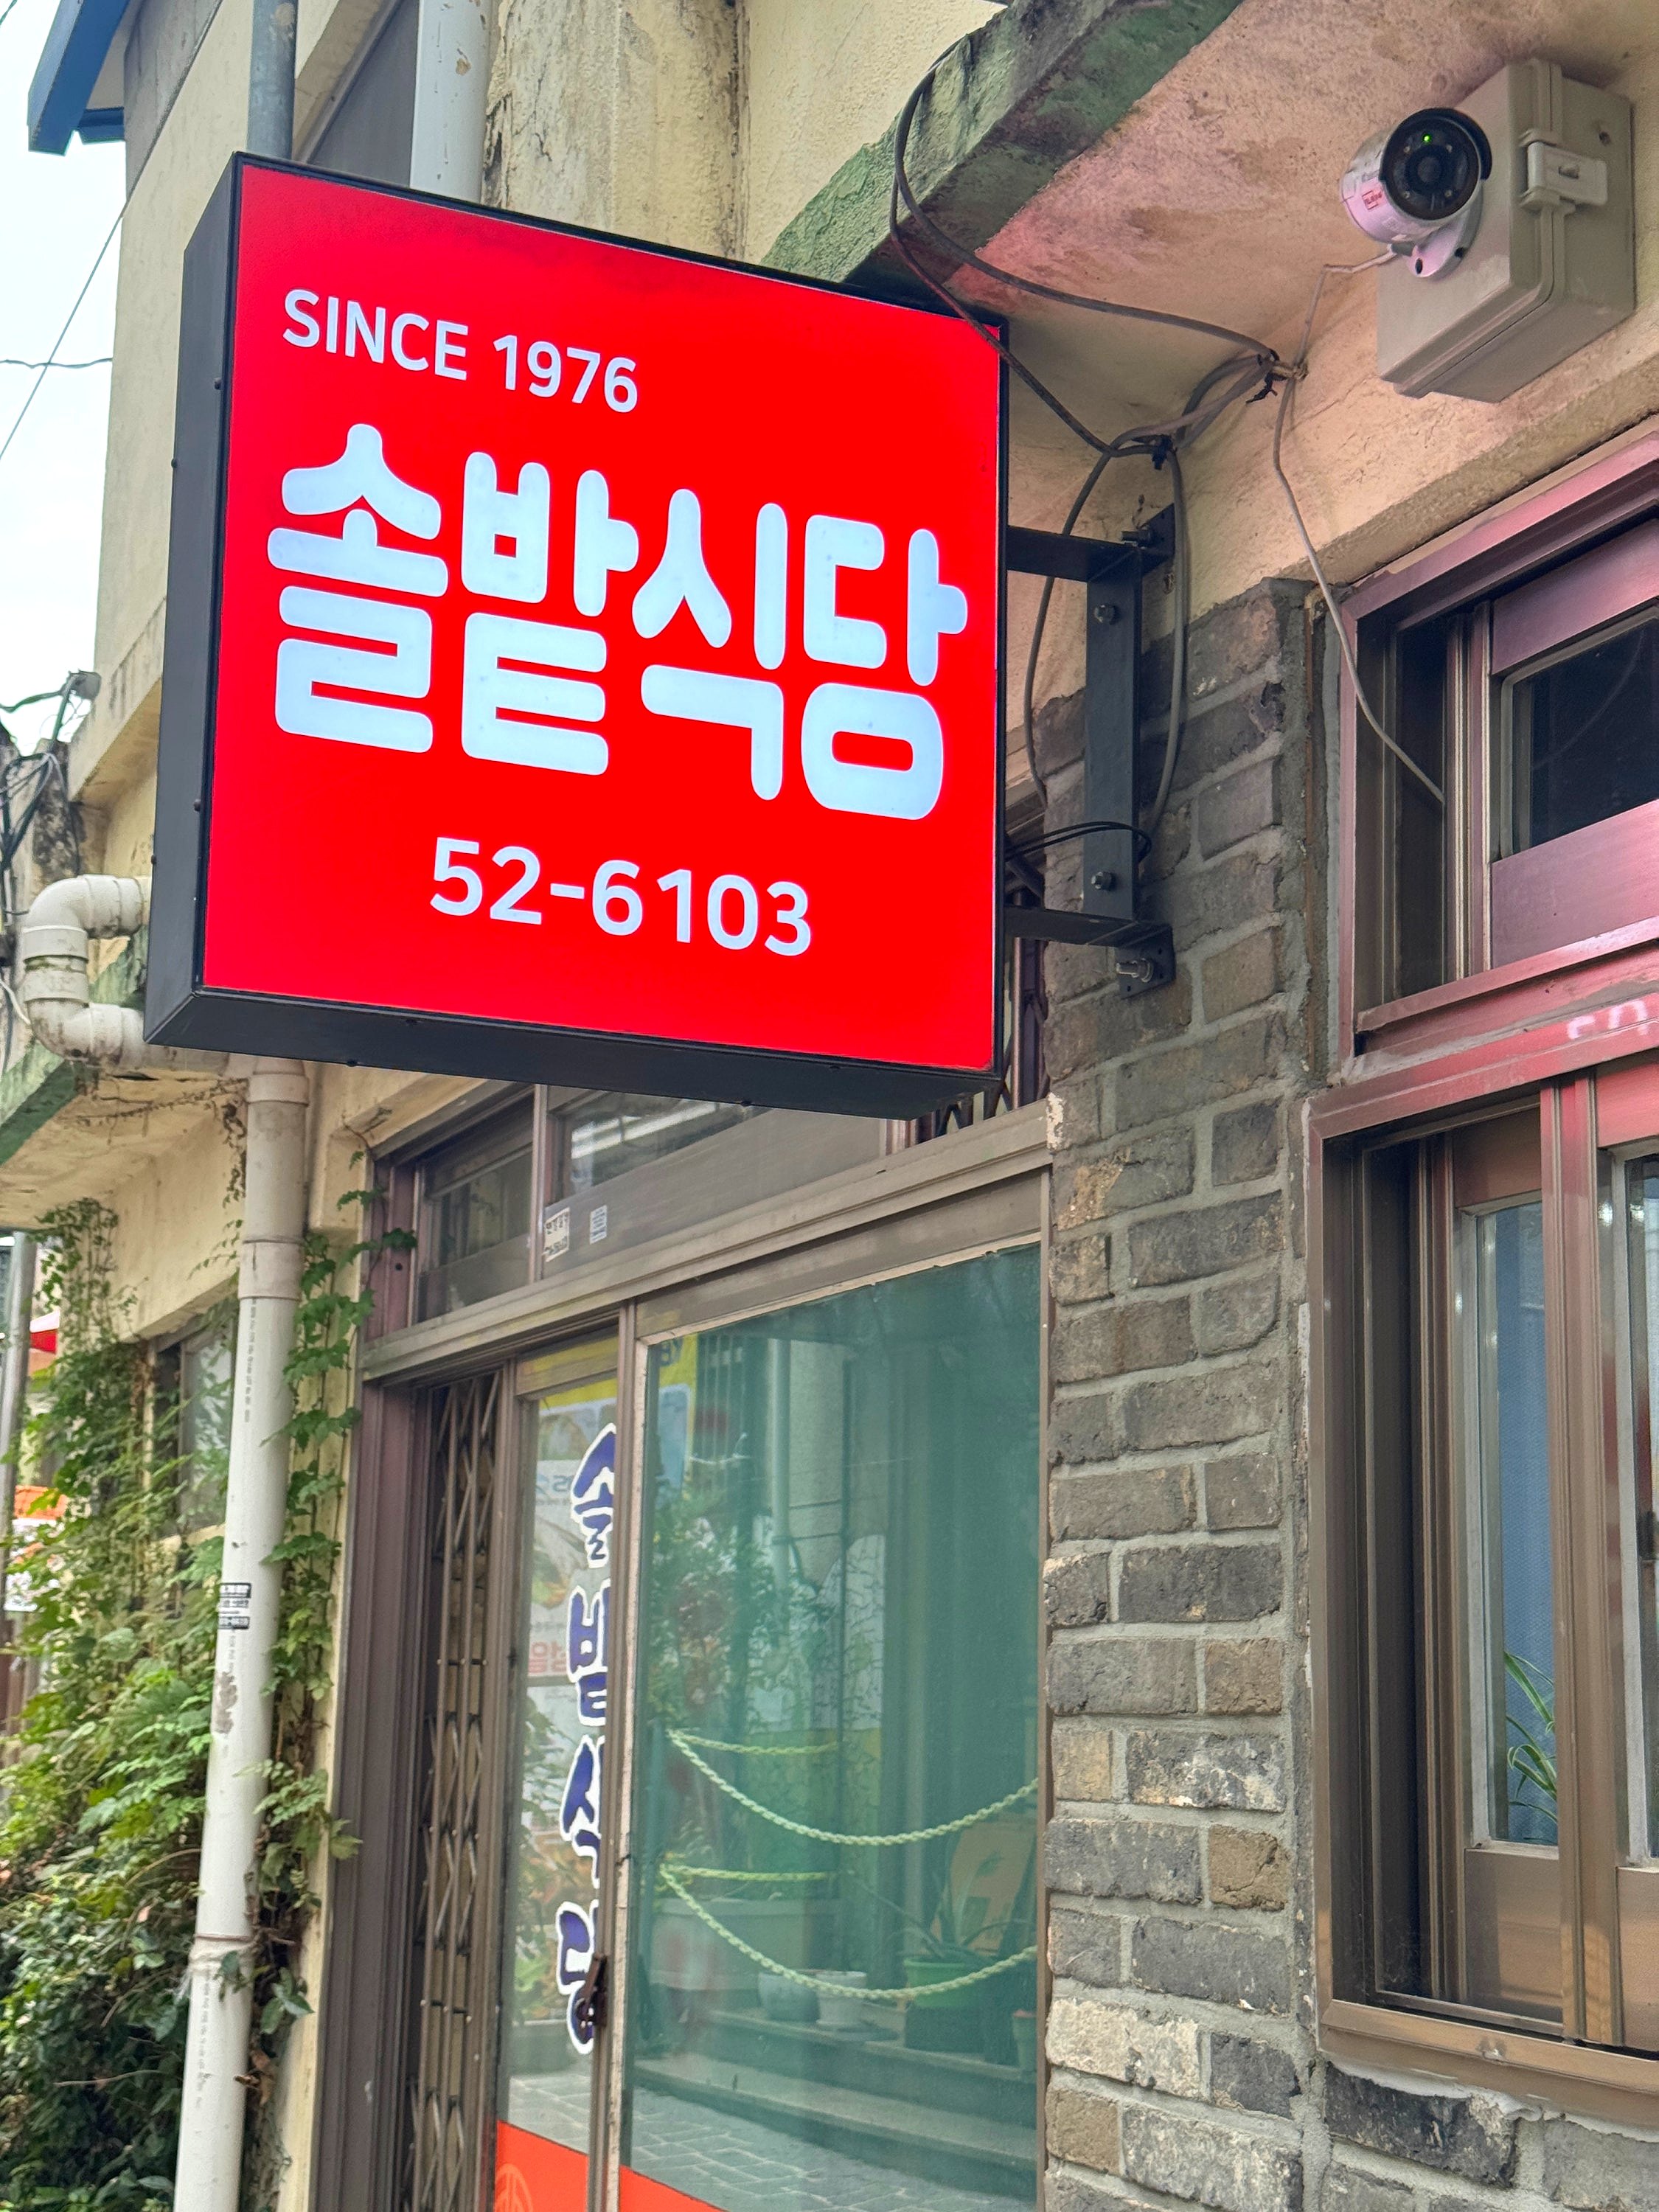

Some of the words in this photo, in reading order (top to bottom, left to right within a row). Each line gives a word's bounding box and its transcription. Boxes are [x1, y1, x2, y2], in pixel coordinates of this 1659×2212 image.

[282, 288, 469, 382] SINCE
[492, 334, 639, 414] 1976
[266, 422, 969, 821] 솔밭식당
[428, 835, 812, 957] 52-6103
